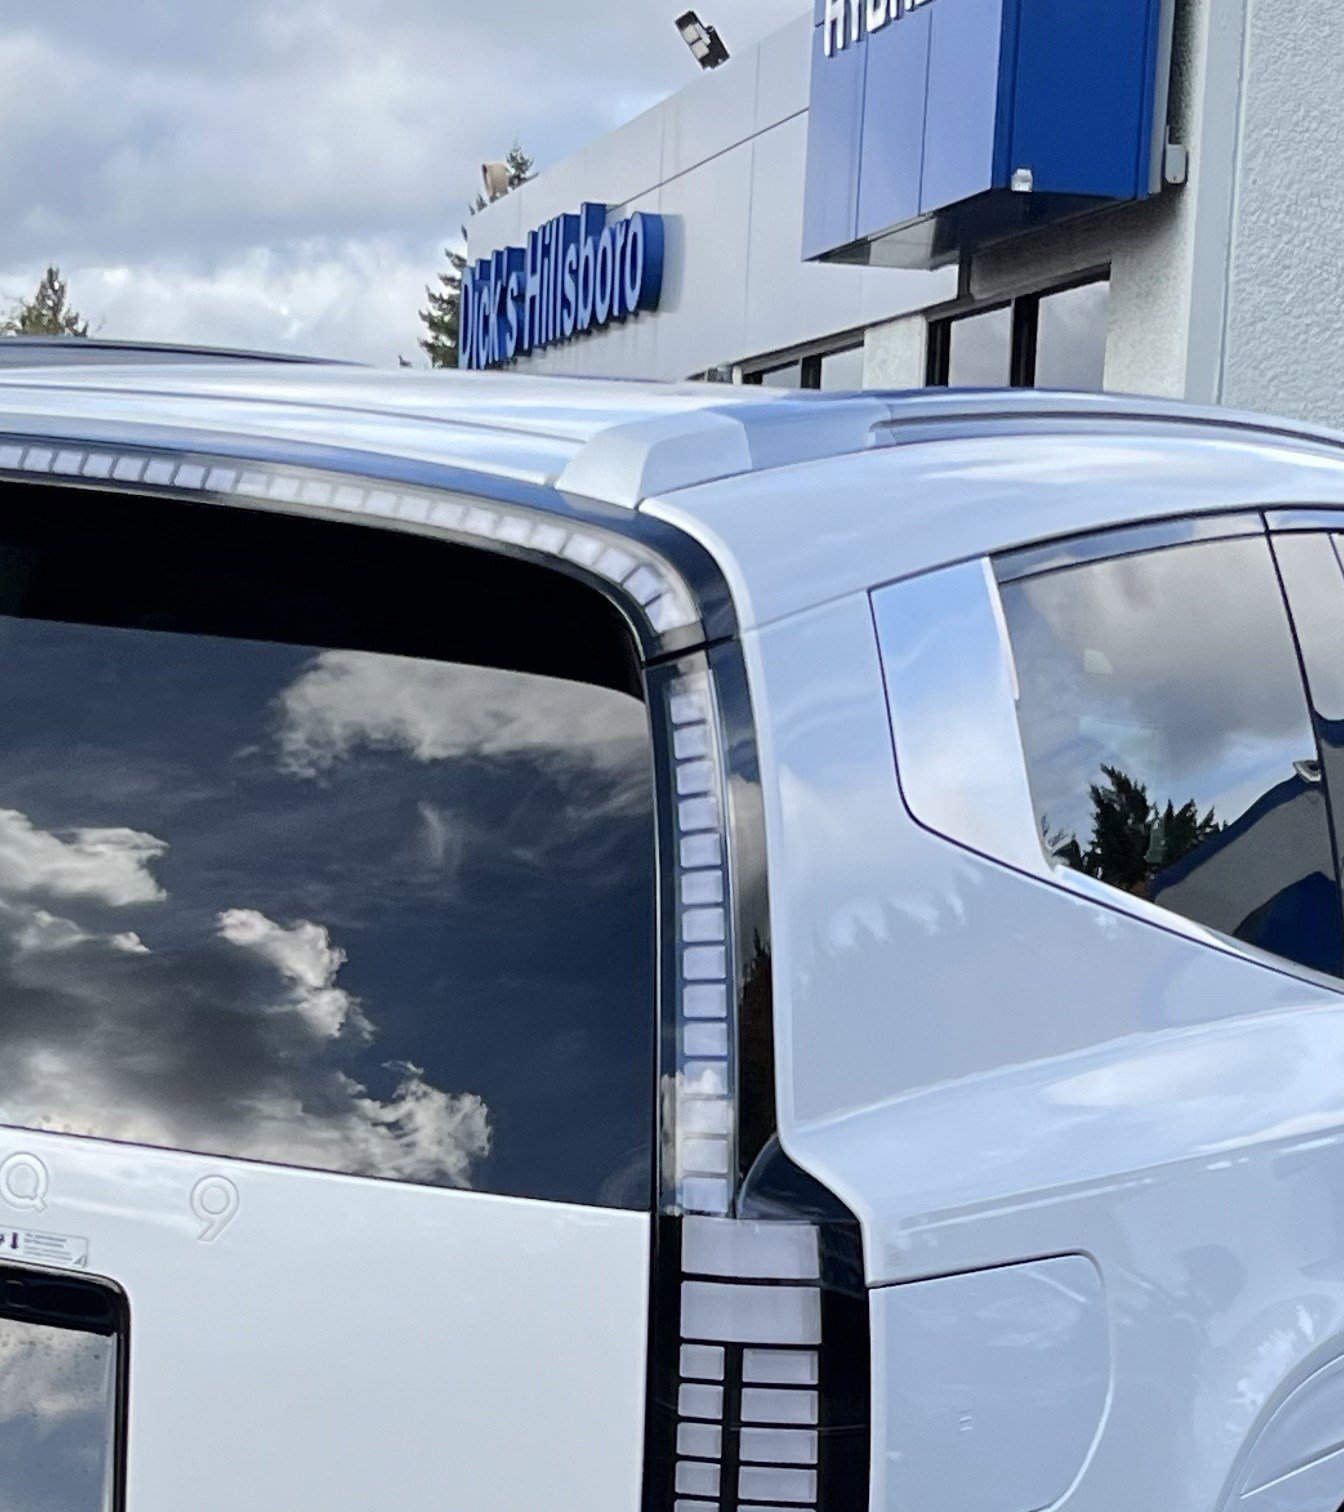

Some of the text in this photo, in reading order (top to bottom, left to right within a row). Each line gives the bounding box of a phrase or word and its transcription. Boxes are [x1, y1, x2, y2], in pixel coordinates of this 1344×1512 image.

[458, 202, 646, 370] Dick's Hillsboro
[188, 1171, 241, 1246] 9
